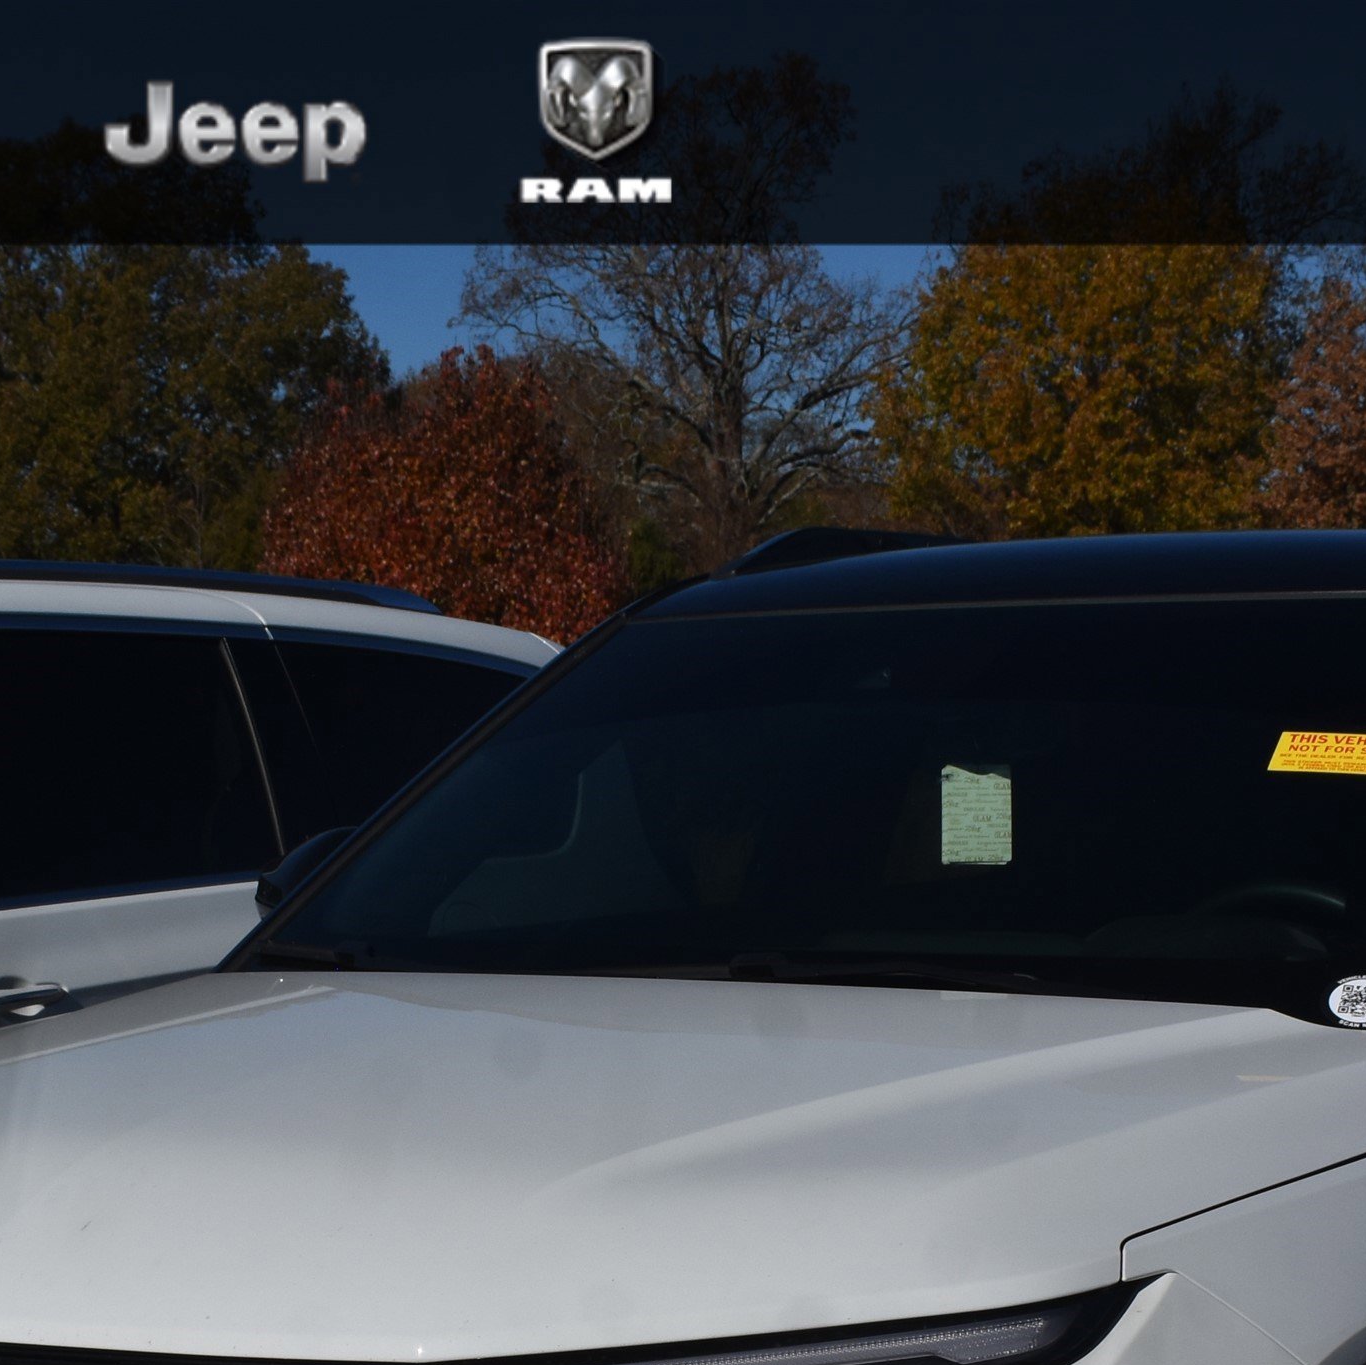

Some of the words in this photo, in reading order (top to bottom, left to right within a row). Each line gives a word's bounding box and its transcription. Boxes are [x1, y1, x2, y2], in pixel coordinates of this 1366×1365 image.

[1290, 733, 1329, 744] THIS
[1288, 744, 1320, 752] NOT
[1324, 745, 1356, 754] FOR
[1337, 975, 1366, 984] VEHICLE
[1338, 1019, 1360, 1028] SCAN
